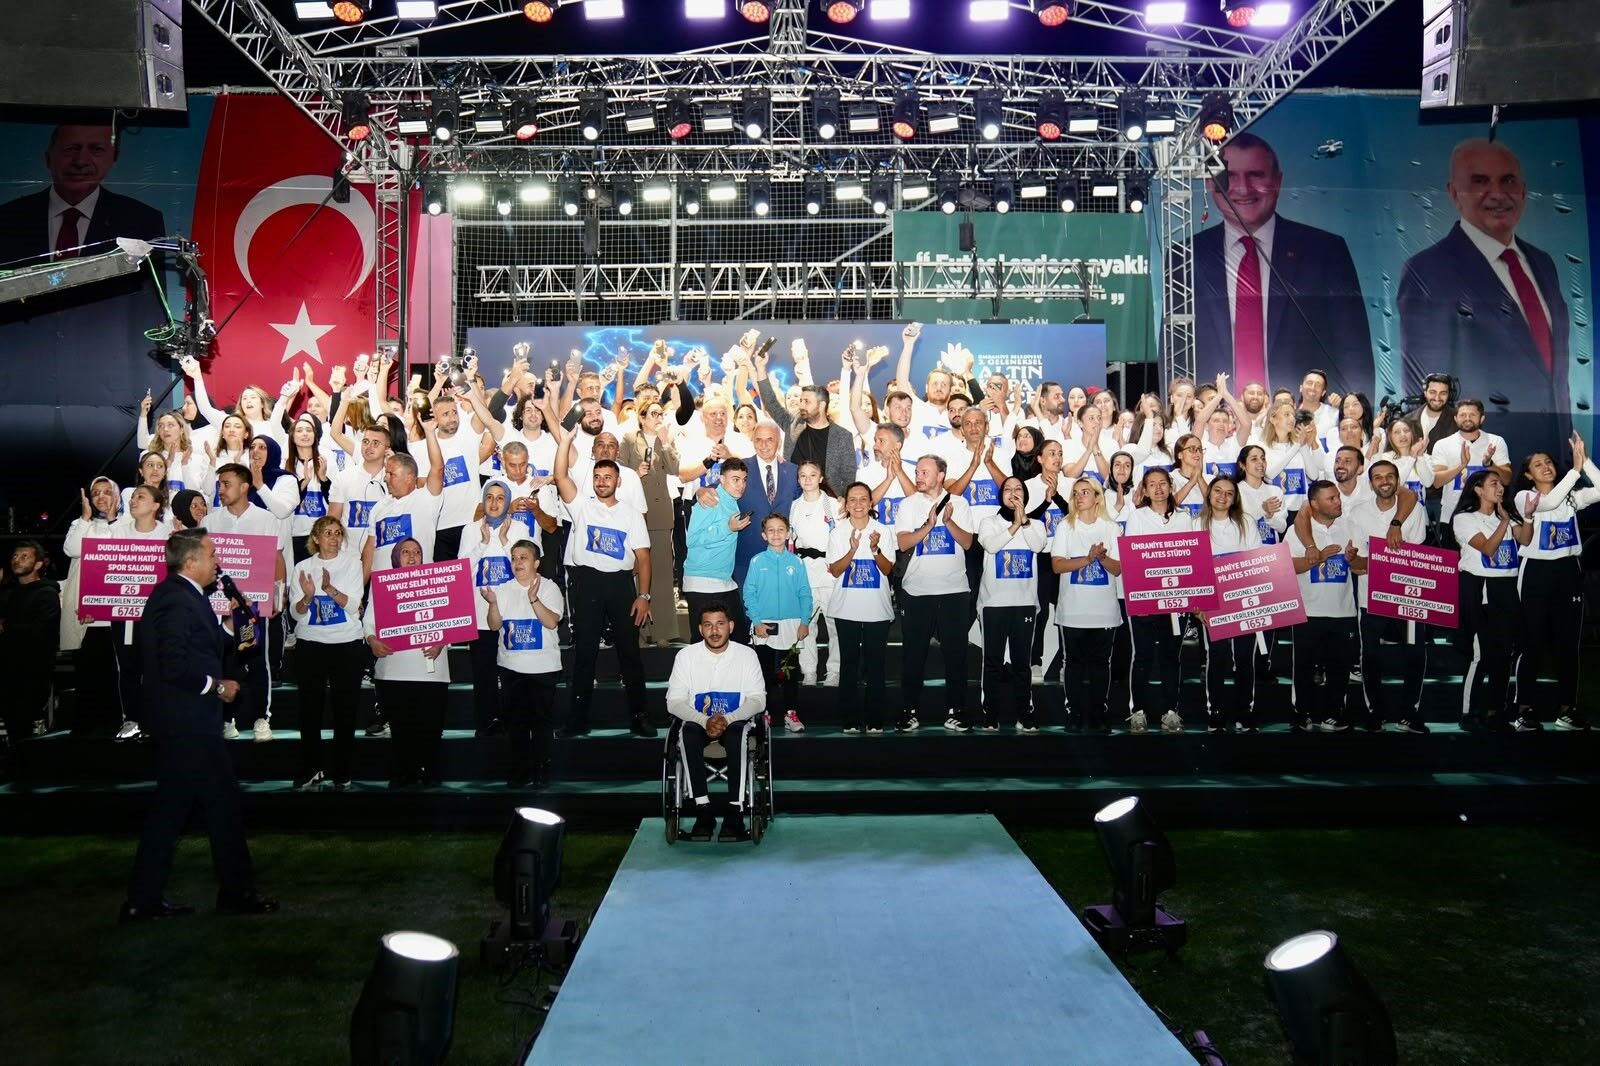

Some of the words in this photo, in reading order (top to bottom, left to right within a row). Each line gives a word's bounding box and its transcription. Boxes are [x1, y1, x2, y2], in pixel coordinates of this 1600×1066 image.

[130, 544, 165, 553] ÜMRANİYE
[1131, 540, 1163, 550] ÜMRANİYE
[1164, 538, 1199, 548] BELEDİYESİ
[118, 553, 137, 562] İMAM
[138, 554, 157, 562] HATİP
[1142, 550, 1166, 559] PİLATES
[1167, 548, 1191, 557] STÜDYO
[1412, 549, 1442, 563] ÜMRANİYE
[1240, 554, 1277, 568] BELEDİYESİ
[1372, 554, 1389, 562] BİROL
[1390, 557, 1409, 566] HAYAL
[1410, 560, 1430, 570] YÜZME
[1431, 565, 1455, 574] HAVUZU
[378, 572, 409, 583] TRABZON
[410, 568, 432, 577] MİLLET
[434, 563, 462, 574] BAHÇESİ
[1218, 573, 1243, 584] PİLATES
[1244, 566, 1270, 579] STÜDYO
[386, 581, 408, 592] YAVUZ
[409, 578, 428, 588] SELİM
[430, 575, 456, 585] TUNCER
[1168, 578, 1173, 587] 6
[1392, 575, 1418, 585] PERSONEL
[125, 586, 136, 594] 26
[396, 590, 414, 600] SPOR
[416, 585, 448, 597] TESİSLERİ
[1225, 590, 1253, 600] PERSONEL
[1408, 587, 1418, 596] 24
[399, 602, 429, 611] PERSONEL
[1164, 599, 1183, 608] 1652
[1248, 598, 1254, 607] 6
[1415, 600, 1436, 608] SPORCU
[118, 608, 140, 616] 6745
[420, 611, 429, 620] 14
[1256, 606, 1278, 616] SPORCU
[1402, 607, 1424, 618] 11856
[428, 621, 452, 630] SPORCU
[1246, 618, 1266, 628] 1652
[414, 632, 440, 643] 13750
